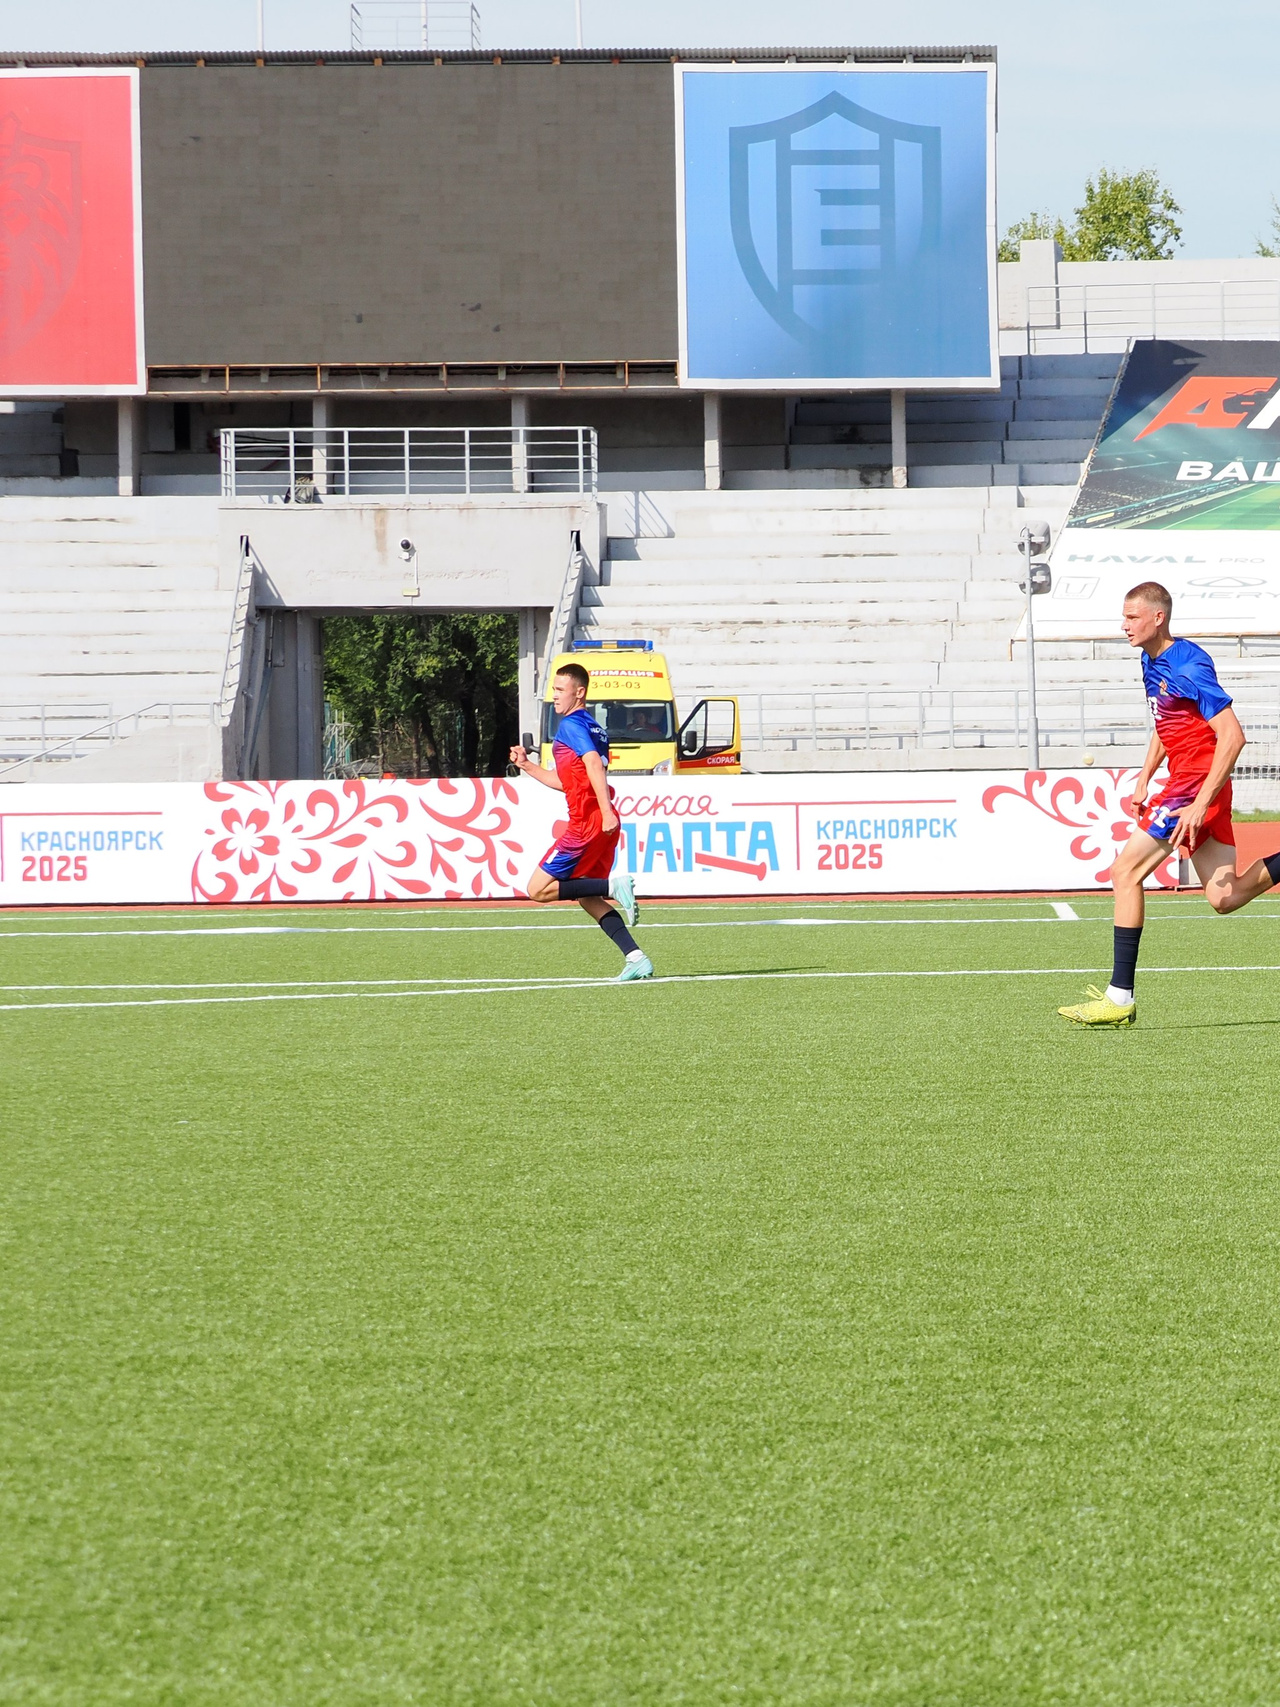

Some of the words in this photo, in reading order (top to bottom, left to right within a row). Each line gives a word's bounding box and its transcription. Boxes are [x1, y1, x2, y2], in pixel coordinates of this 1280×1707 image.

[1067, 554, 1206, 563] HAVAL
[590, 669, 655, 678] НИМАЦИЯ
[591, 680, 641, 689] 3-03-03
[706, 756, 735, 765] СКОРАЯ
[614, 795, 720, 817] сская
[817, 818, 957, 840] КРАСНОЯРСК
[21, 831, 163, 851] КРАСНОЯРСК
[817, 843, 883, 870] 2025
[22, 855, 87, 882] 2025
